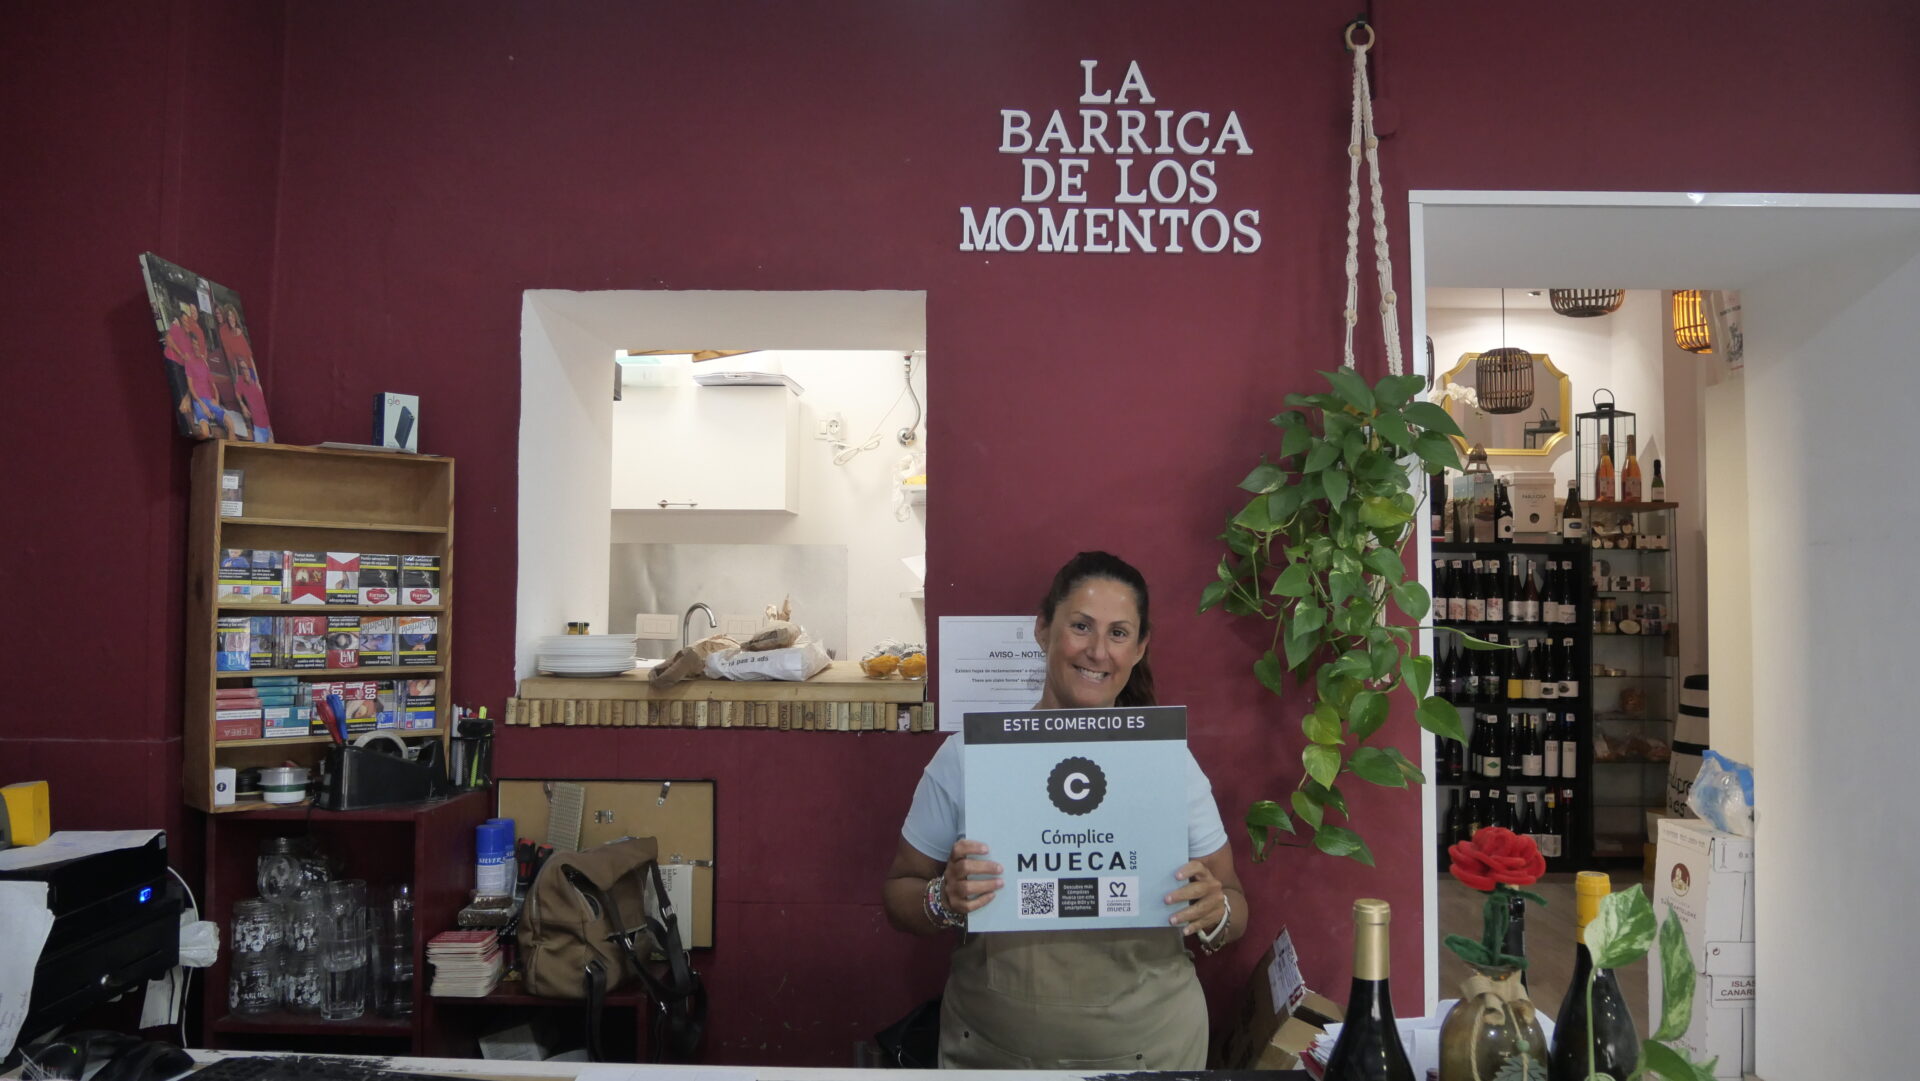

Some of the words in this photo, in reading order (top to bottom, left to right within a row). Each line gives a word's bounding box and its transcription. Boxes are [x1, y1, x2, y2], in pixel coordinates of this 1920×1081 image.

[1079, 60, 1156, 104] LA
[998, 110, 1253, 155] BARRICA
[1021, 158, 1089, 203] DE
[1114, 159, 1218, 204] LOS
[960, 206, 1262, 254] MOMENTOS
[340, 651, 354, 662] L&M
[1003, 718, 1040, 732] ESTE
[1044, 716, 1121, 730] COMERCIO
[1126, 716, 1145, 729] ES
[1063, 772, 1090, 800] C
[1041, 829, 1114, 848] Cómplice
[1018, 851, 1126, 872] MUECA
